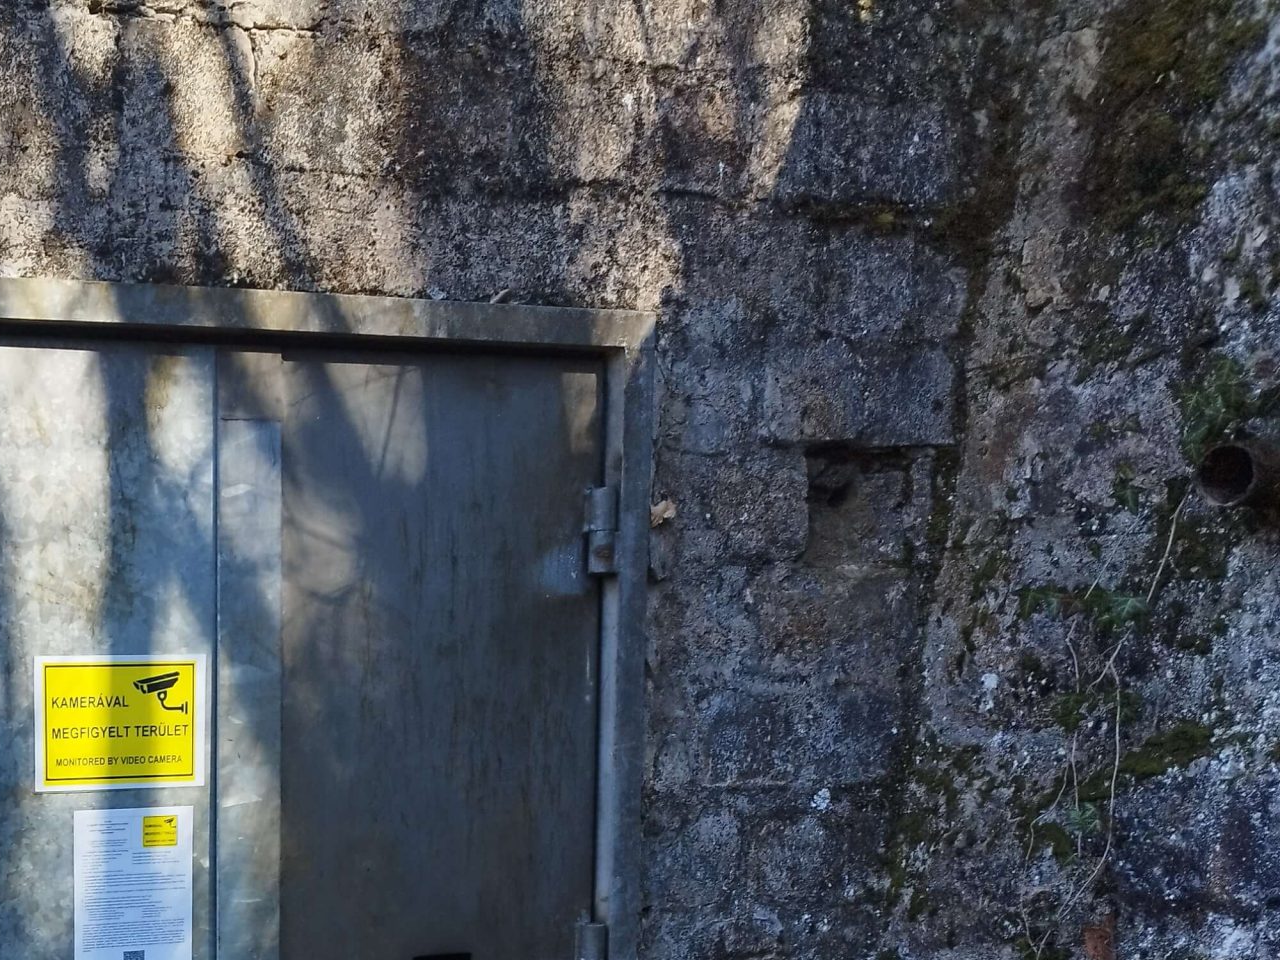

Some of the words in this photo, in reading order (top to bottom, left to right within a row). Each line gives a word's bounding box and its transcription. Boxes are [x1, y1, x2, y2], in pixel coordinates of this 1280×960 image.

[51, 692, 129, 709] KAMERÁVAL
[51, 725, 130, 739] MEGFIGYELT
[134, 722, 189, 739] TERÜLET
[55, 757, 106, 767] MONITORED
[107, 756, 119, 766] BY
[121, 755, 146, 765] VIDEO
[147, 754, 183, 764] CAMERA
